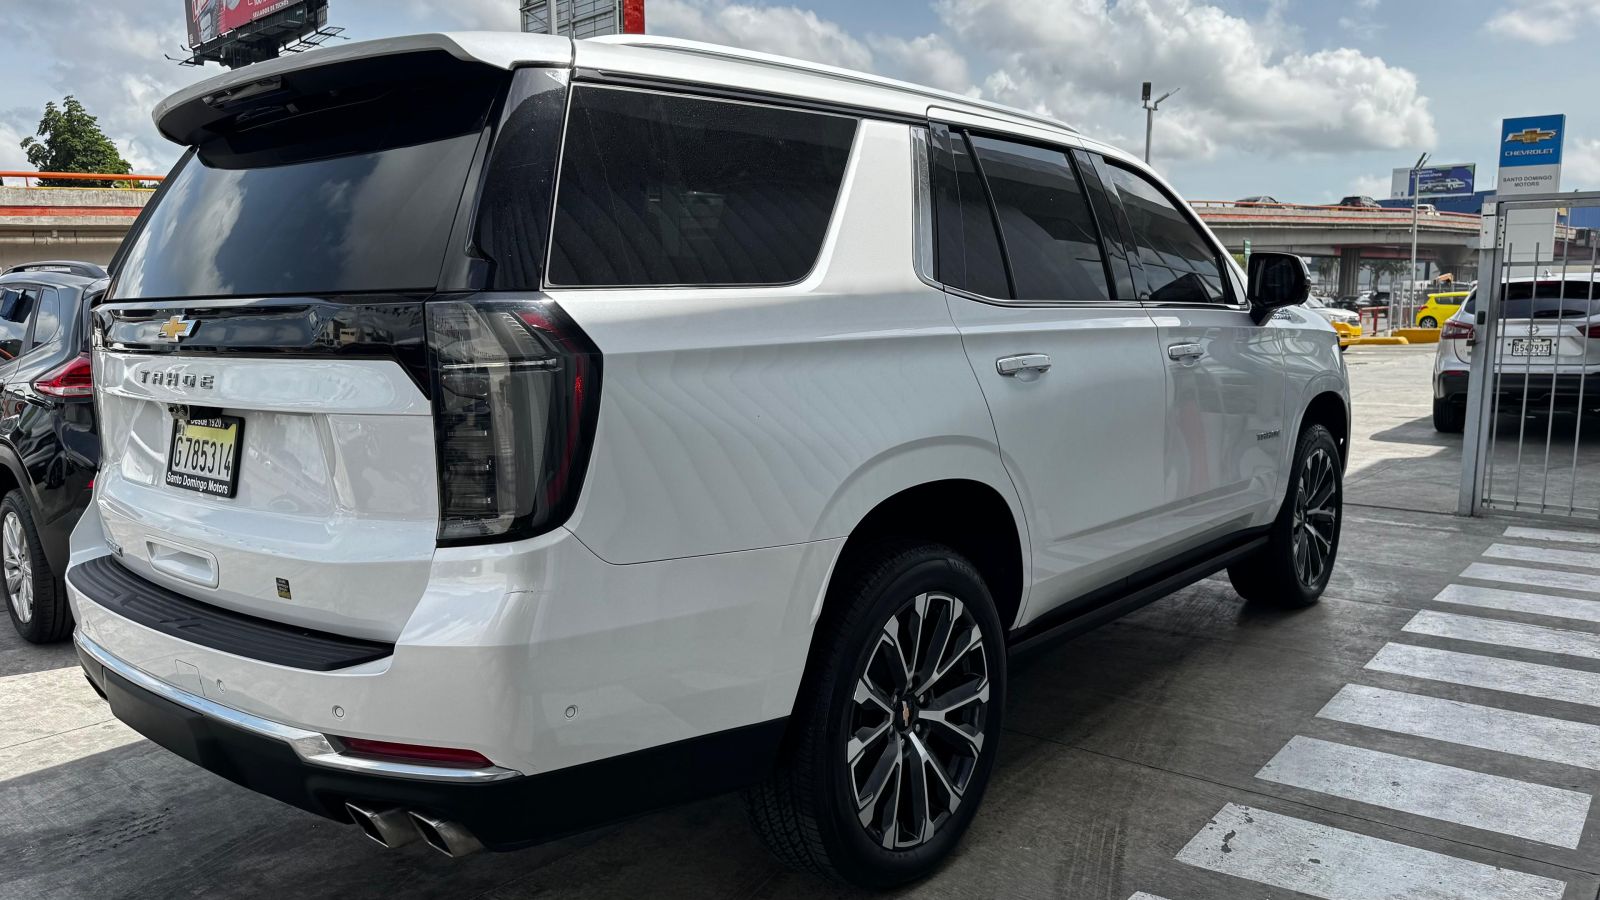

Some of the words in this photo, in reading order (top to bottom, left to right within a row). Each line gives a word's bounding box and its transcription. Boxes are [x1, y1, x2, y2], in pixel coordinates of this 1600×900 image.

[1504, 148, 1554, 157] CHEVROLET
[140, 370, 215, 389] TAHOE
[174, 436, 232, 477] G785314
[166, 471, 182, 485] Santo
[182, 474, 207, 491] Domingo
[207, 480, 228, 494] Motors
